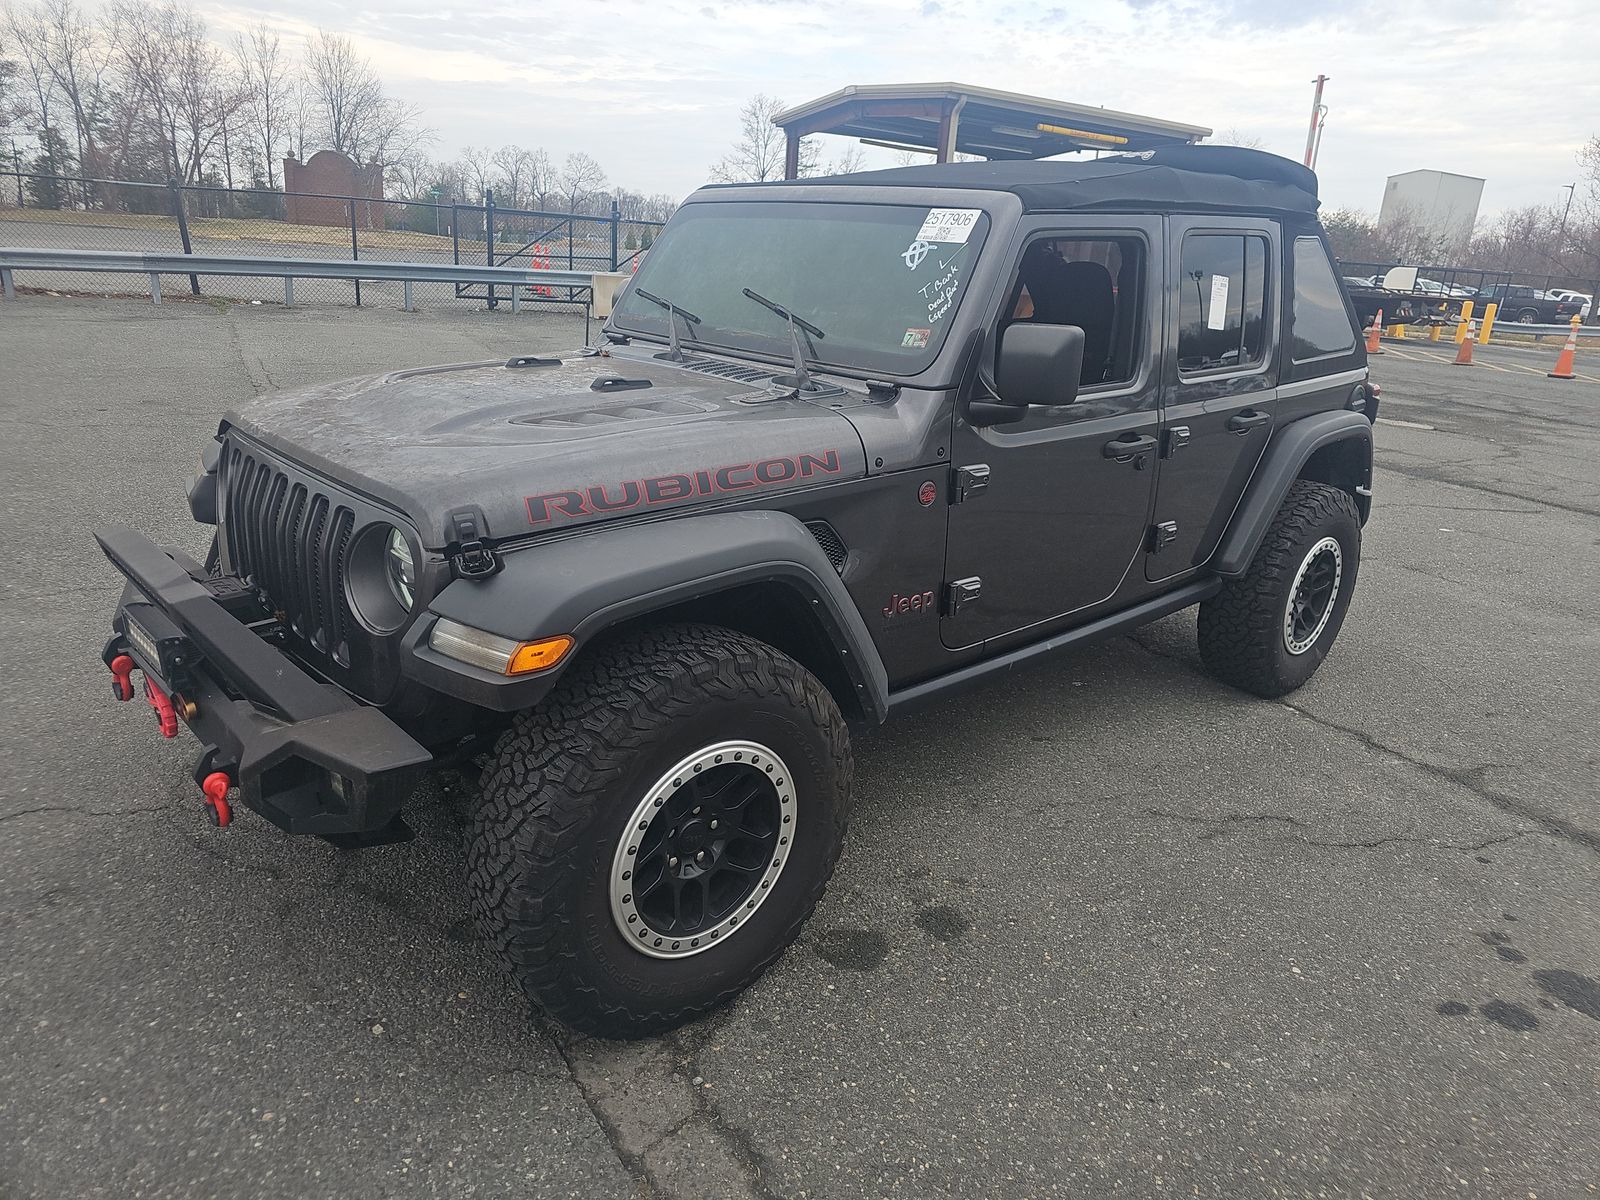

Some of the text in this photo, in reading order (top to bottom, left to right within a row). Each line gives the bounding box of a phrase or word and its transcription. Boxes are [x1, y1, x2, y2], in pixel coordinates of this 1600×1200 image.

[925, 212, 973, 226] 2517906
[523, 448, 841, 525] RUBICON
[882, 591, 934, 620] Jeep
